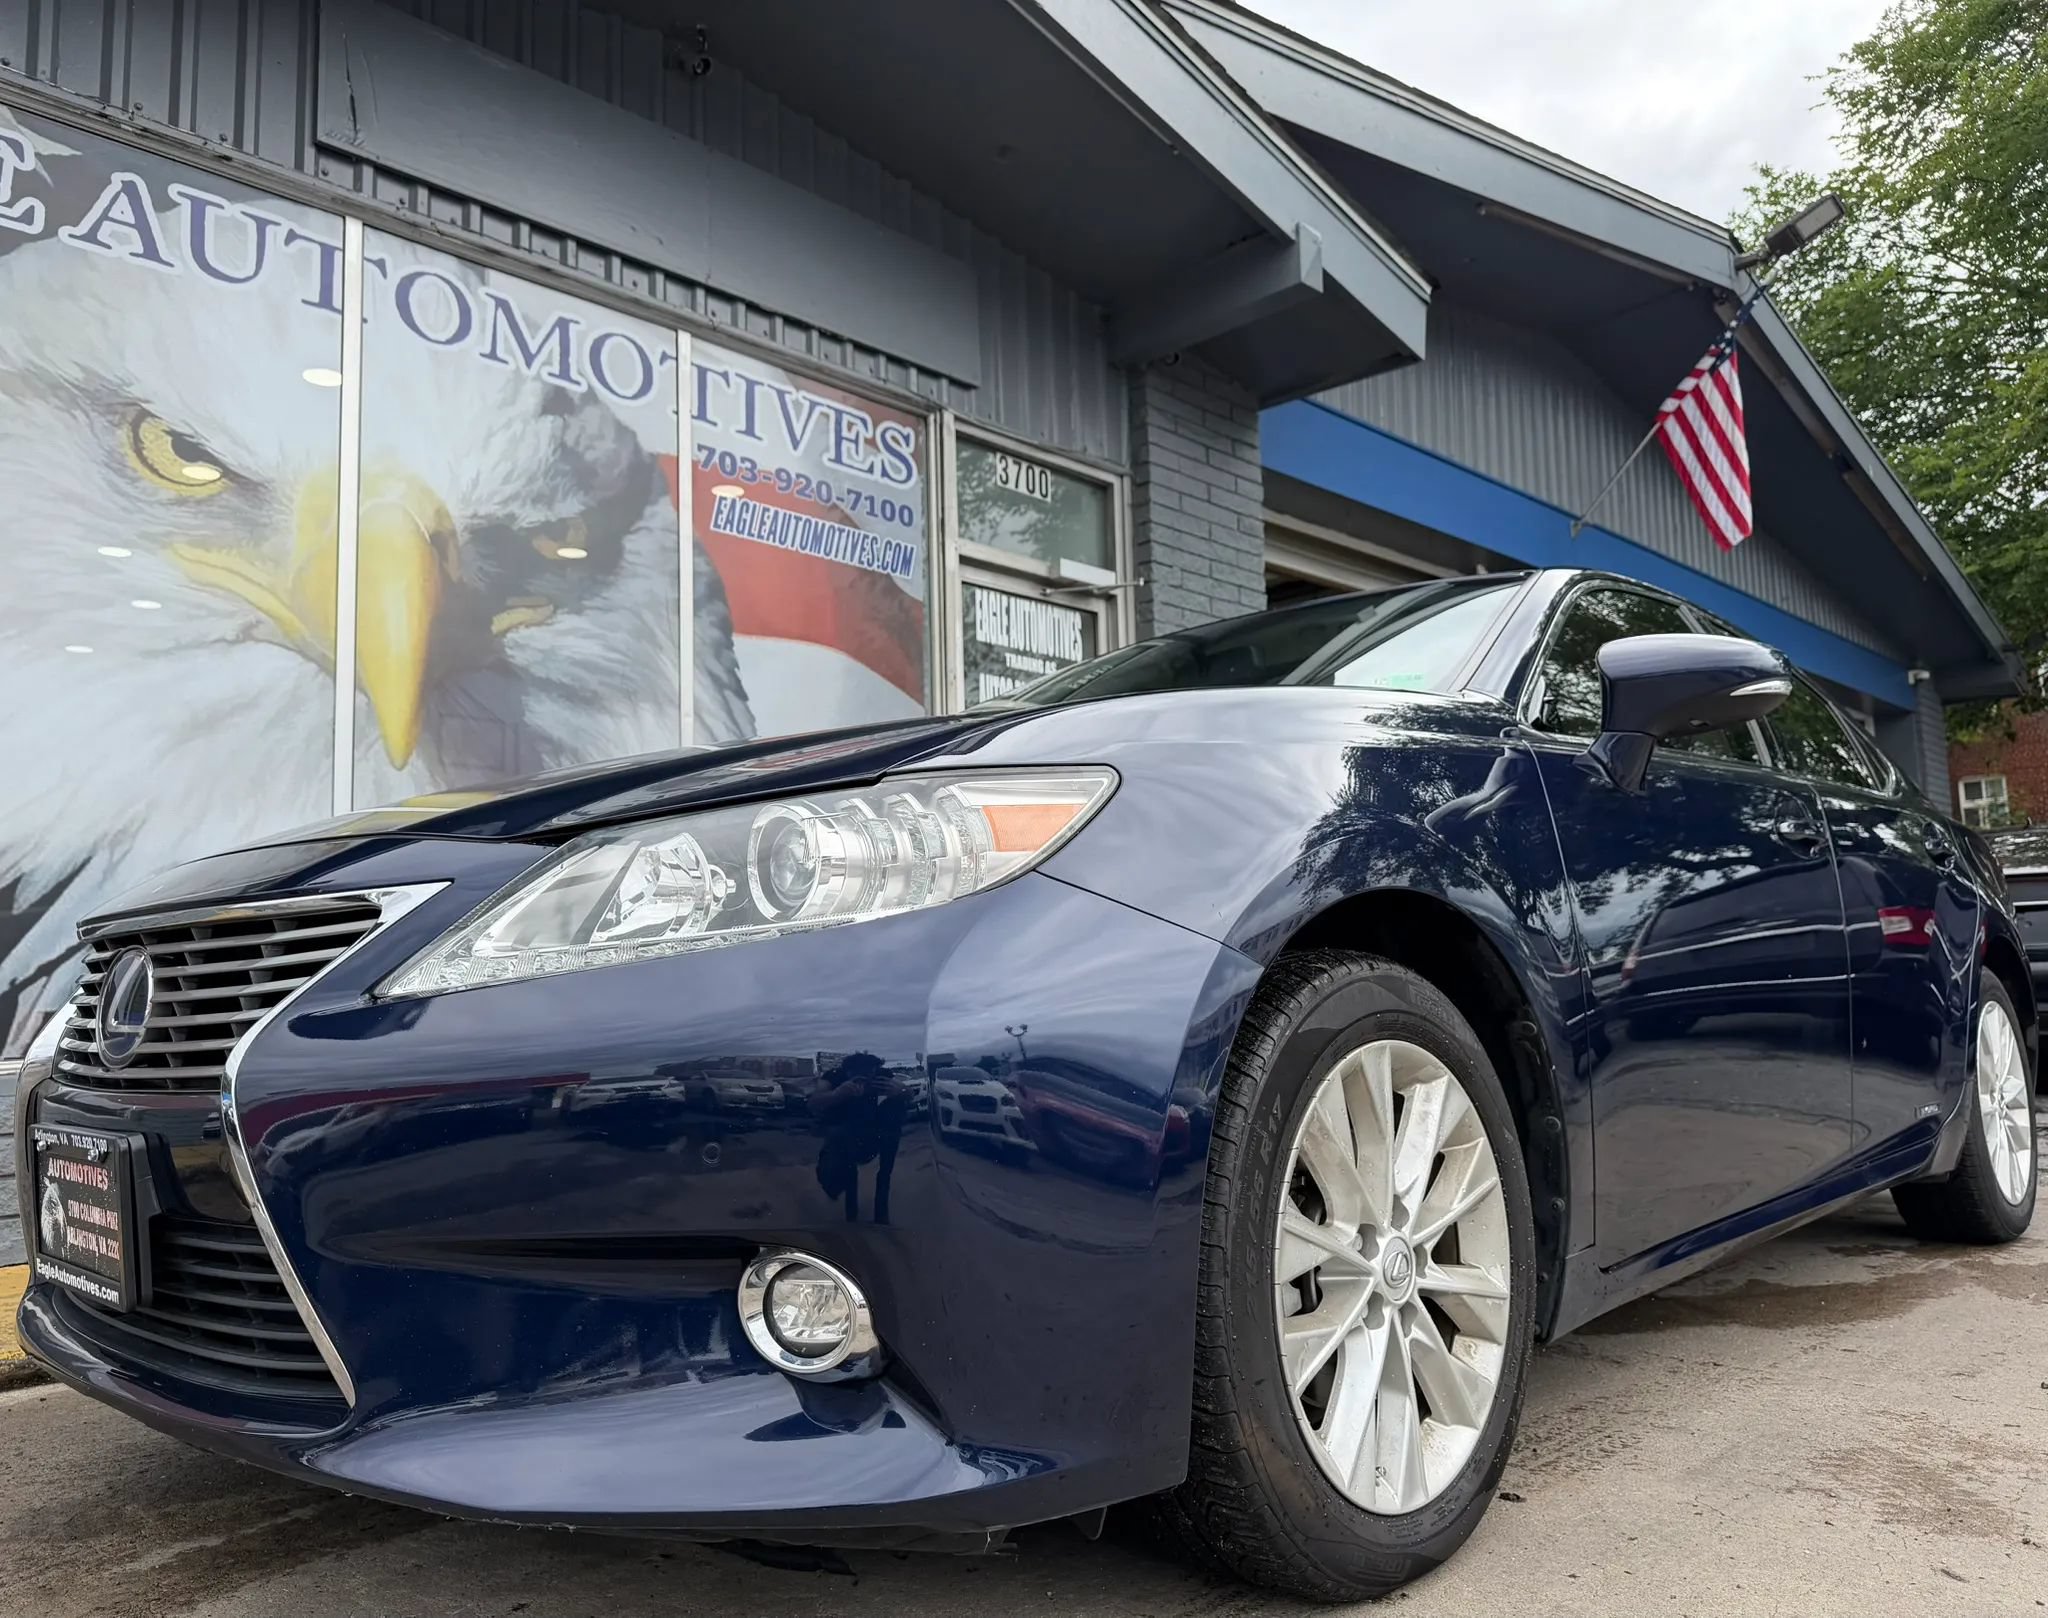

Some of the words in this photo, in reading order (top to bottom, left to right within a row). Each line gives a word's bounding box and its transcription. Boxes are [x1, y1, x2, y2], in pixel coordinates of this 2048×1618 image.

[67, 178, 915, 485] AUTOMOTIVES
[697, 443, 914, 528] 703-920-7100
[999, 454, 1048, 498] 3700
[712, 495, 915, 578] EAGLEAUTOMOTIVES.COM
[975, 587, 1010, 649] EAGLE
[1009, 595, 1083, 663] AUTOMOTIVES
[47, 1157, 109, 1191] AUTOMOTIVES
[36, 1257, 120, 1304] EagleAutomotives.com
